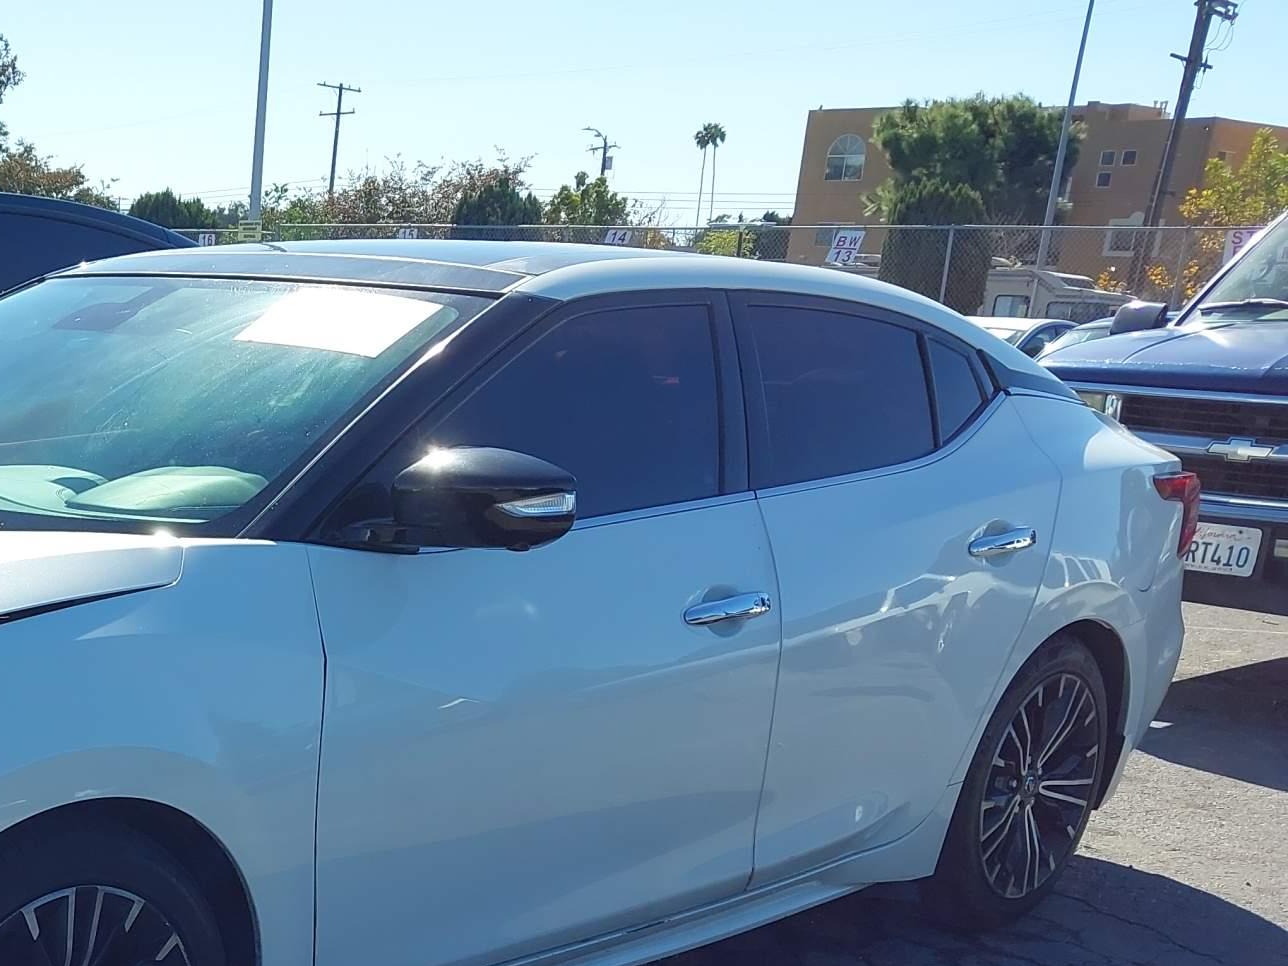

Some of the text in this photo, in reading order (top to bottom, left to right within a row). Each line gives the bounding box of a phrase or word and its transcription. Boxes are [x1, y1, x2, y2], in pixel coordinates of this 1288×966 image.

[203, 234, 214, 246] 16
[612, 230, 627, 243] 14
[836, 235, 861, 247] BW
[834, 250, 852, 262] 13
[1185, 540, 1251, 569] RT410
